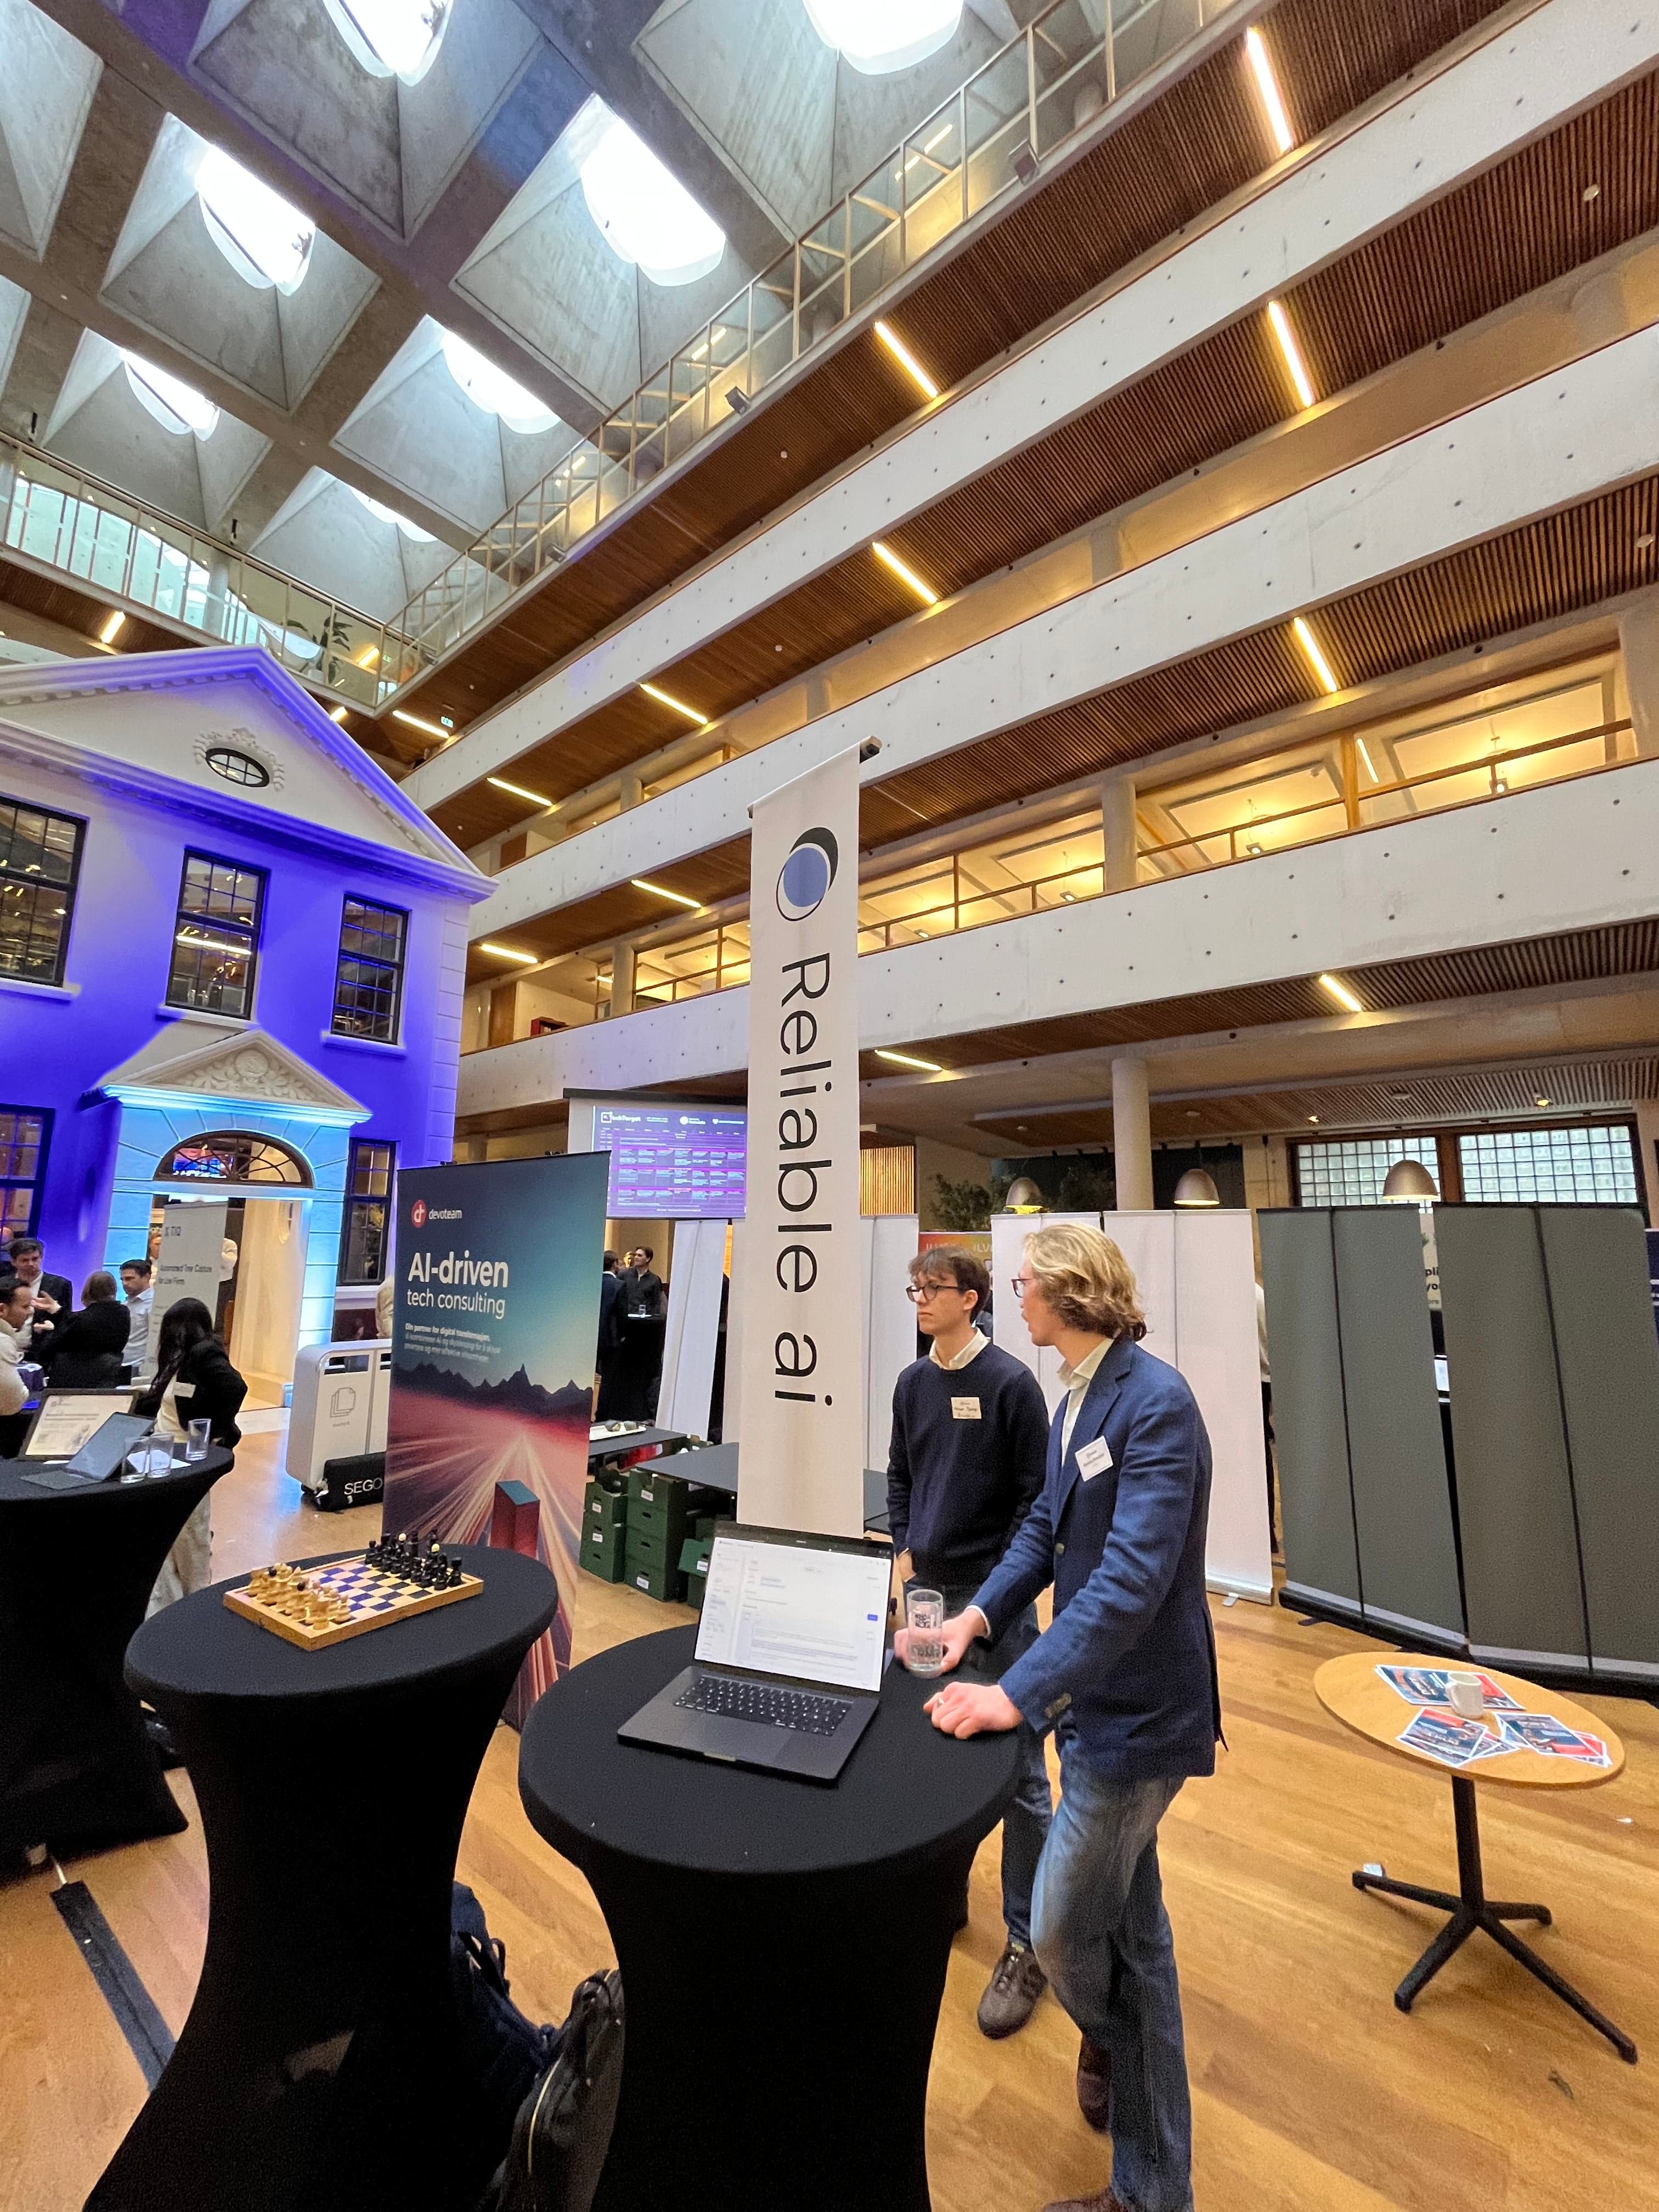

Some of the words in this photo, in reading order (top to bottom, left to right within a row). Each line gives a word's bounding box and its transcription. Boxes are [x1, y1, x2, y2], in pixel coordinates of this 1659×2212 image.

[777, 953, 832, 1292] Reliable
[428, 1209, 462, 1220] devoteam
[408, 1250, 509, 1288] AI-driven
[407, 1288, 434, 1307] tech
[437, 1291, 505, 1319] consulting
[775, 1333, 832, 1406] ai
[343, 1477, 383, 1495] SEGO
